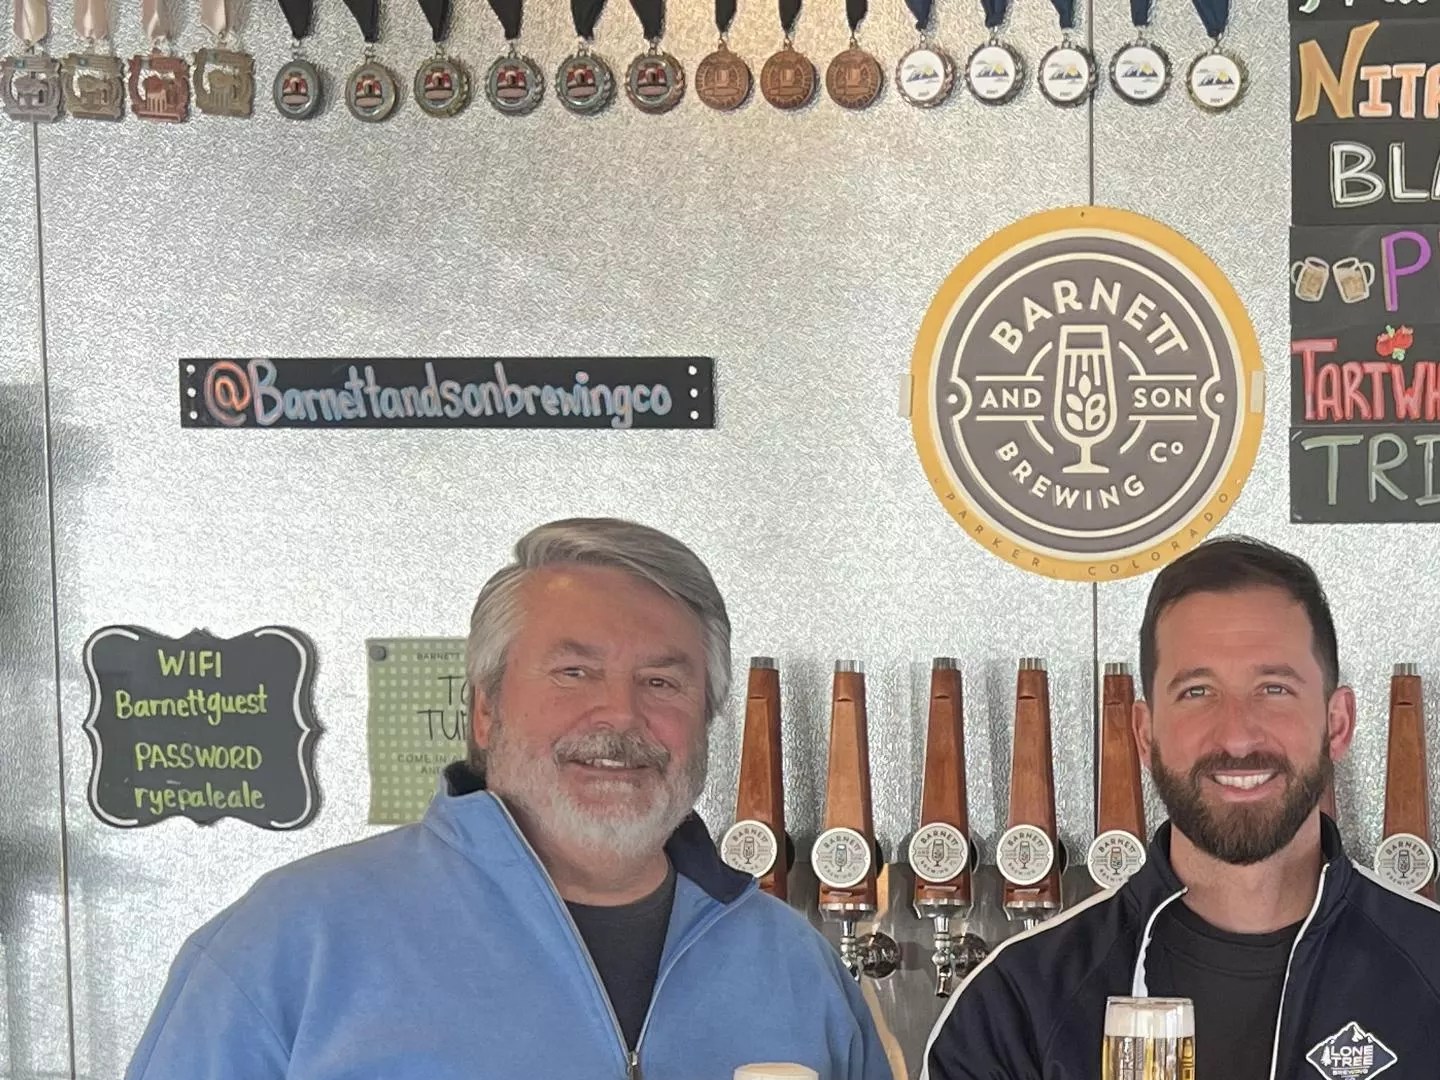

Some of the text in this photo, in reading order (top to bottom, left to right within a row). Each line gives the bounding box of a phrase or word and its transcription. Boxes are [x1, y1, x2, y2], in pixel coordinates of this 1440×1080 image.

[988, 277, 1189, 356] BARNETT
[980, 387, 1193, 409] AND SON
[995, 440, 1146, 511] BREWING
[943, 490, 1042, 569] PARKER
[158, 648, 223, 679] WIFI
[114, 683, 268, 726] Barnettguest
[135, 741, 263, 772] PASSWORD
[133, 779, 266, 815] ryepaleale
[1330, 1044, 1374, 1057] LONE
[1330, 1056, 1374, 1068] TREE
